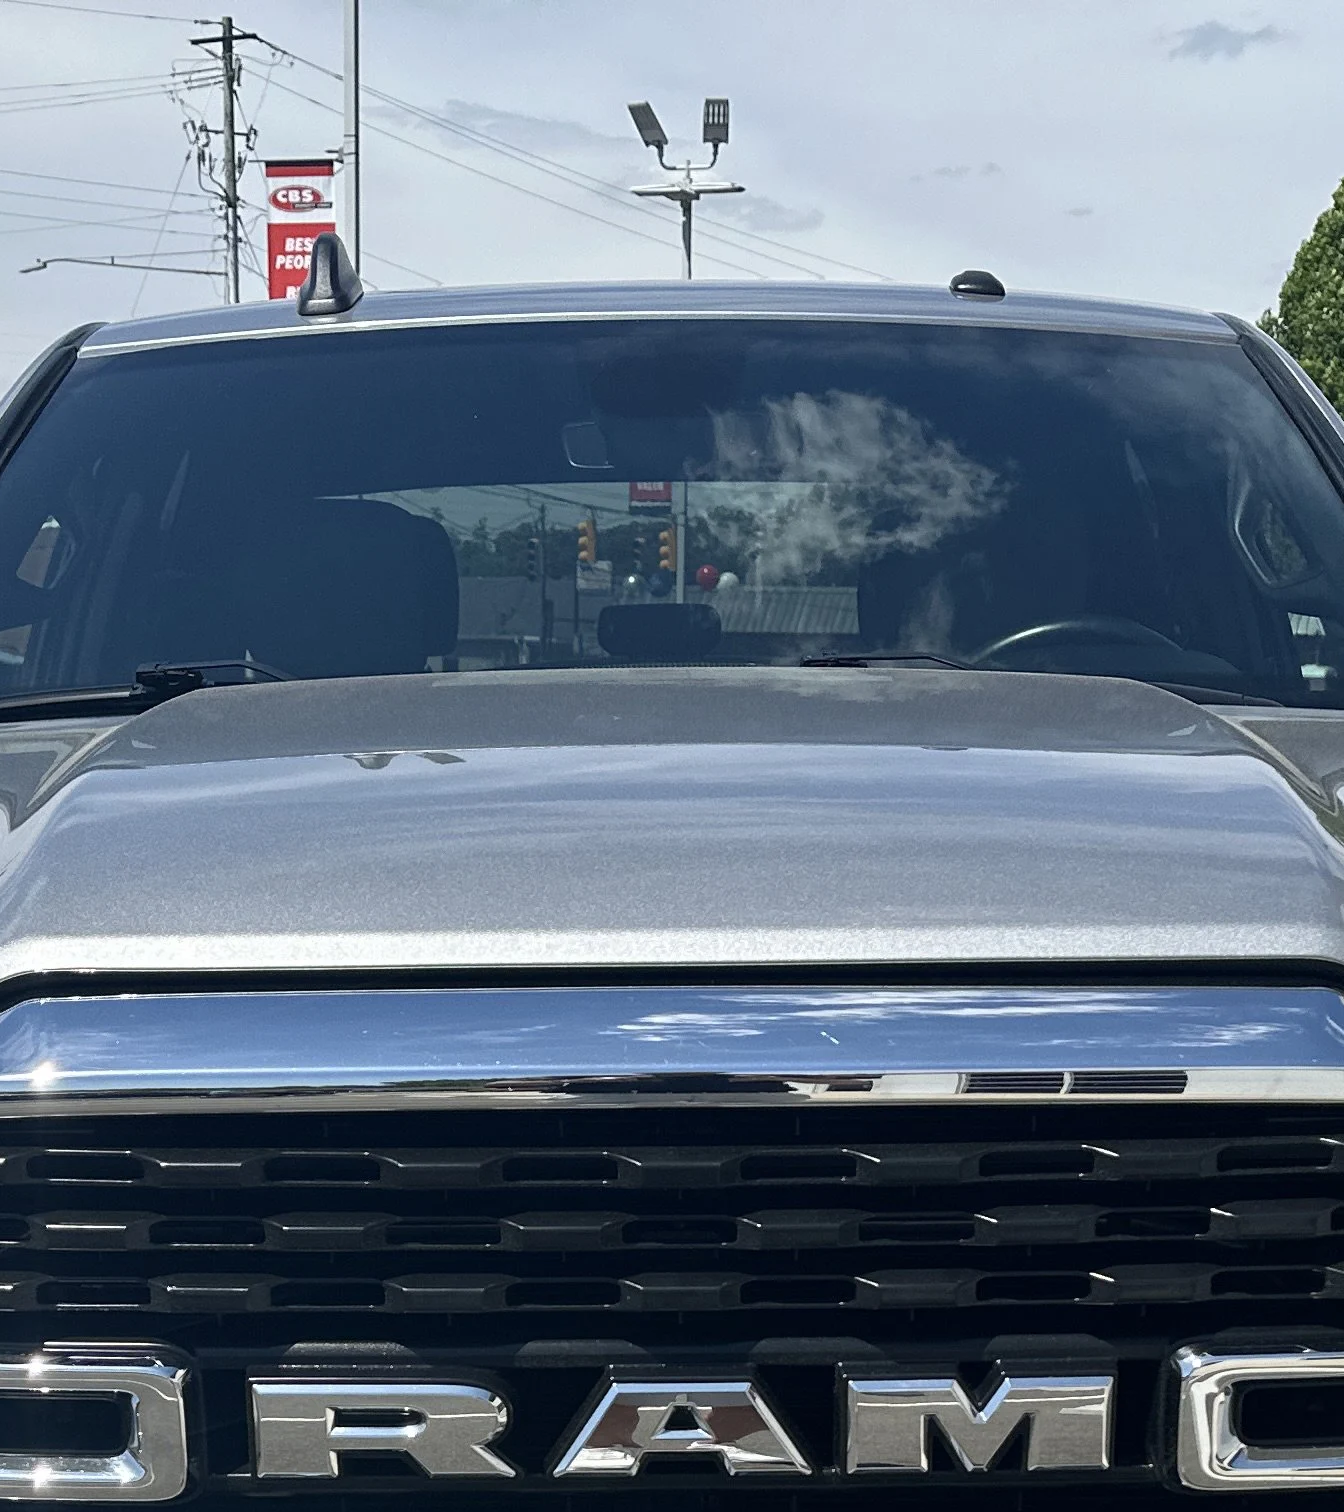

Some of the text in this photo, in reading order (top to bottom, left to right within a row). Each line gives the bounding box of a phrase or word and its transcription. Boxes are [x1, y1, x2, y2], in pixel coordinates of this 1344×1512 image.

[276, 189, 314, 202] CBS
[284, 237, 314, 251] BES
[250, 1374, 1115, 1479] RAM
